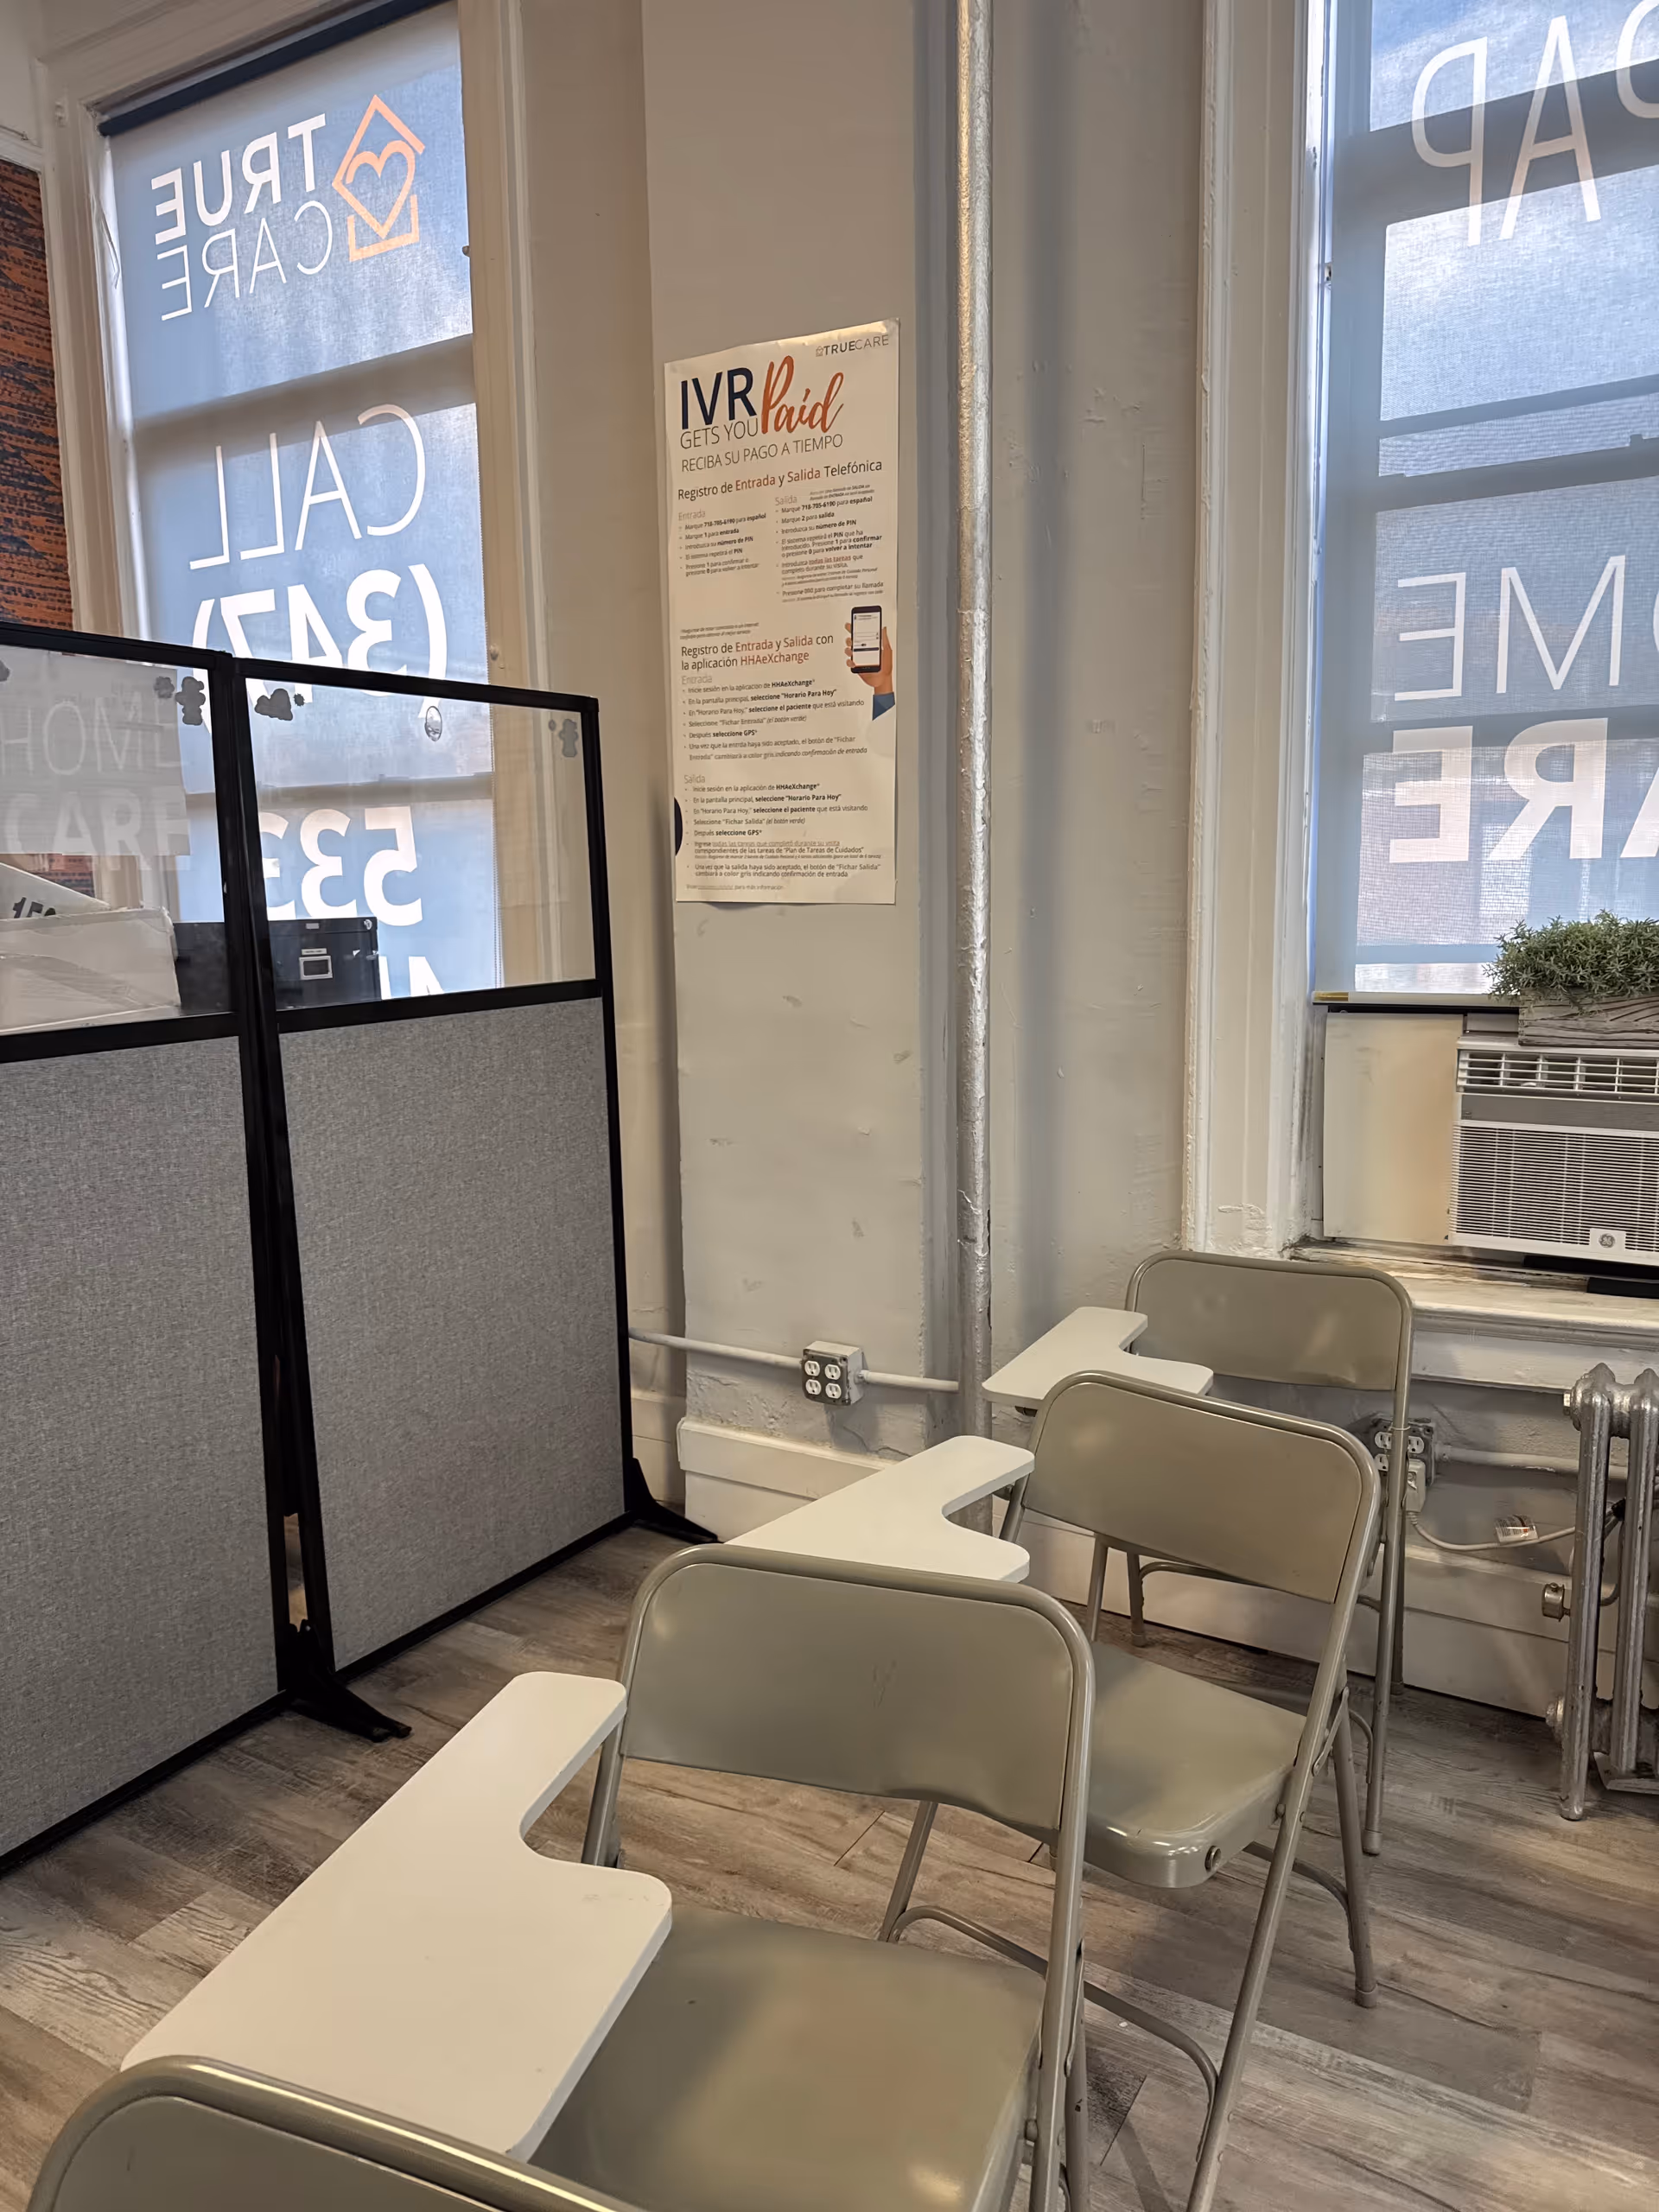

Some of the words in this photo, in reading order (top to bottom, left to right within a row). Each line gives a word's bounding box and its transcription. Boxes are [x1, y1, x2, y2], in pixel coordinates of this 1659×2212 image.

[823, 334, 889, 356] TRUECARE
[680, 426, 720, 449] GETS
[724, 418, 759, 441] YOU
[761, 355, 844, 435] Paid
[681, 367, 757, 430] IVR
[681, 453, 722, 472] RECIBA
[724, 450, 740, 465] SU
[742, 444, 778, 462] PAGO
[791, 433, 843, 454] TIEMPO
[677, 483, 718, 502] Registro
[720, 481, 733, 493] de
[734, 474, 776, 491] Entrada
[786, 467, 821, 483] Salida
[823, 458, 882, 478] Telefónica
[774, 494, 798, 505] Salida
[849, 496, 873, 505] español
[677, 507, 705, 520] Entrada
[746, 512, 766, 522] español
[852, 533, 882, 542] confirmar
[680, 644, 718, 658] Registro
[723, 642, 733, 652] de
[734, 639, 773, 652] Entrada
[782, 635, 812, 647] Salida
[815, 635, 834, 645] con
[681, 660, 689, 670] la
[690, 656, 737, 671] aplicación
[740, 650, 809, 667] HHAeXchange
[681, 674, 712, 684] Entrada
[683, 774, 705, 784] Salida
